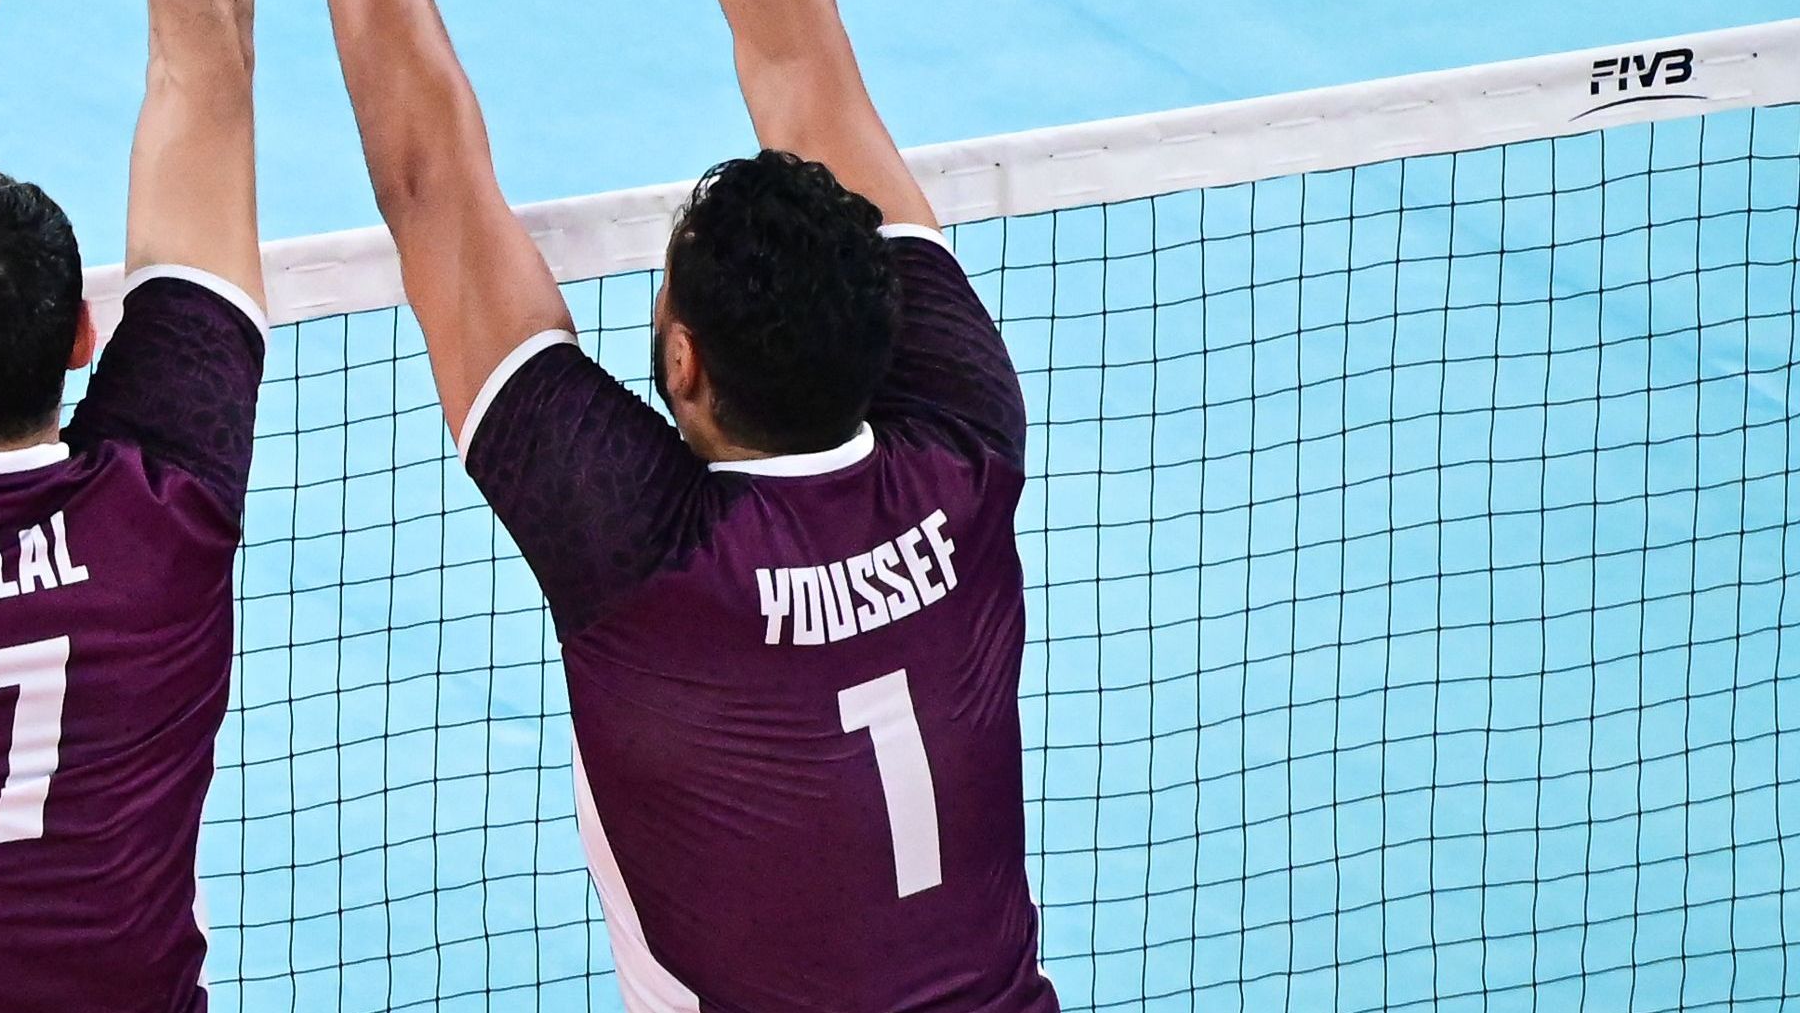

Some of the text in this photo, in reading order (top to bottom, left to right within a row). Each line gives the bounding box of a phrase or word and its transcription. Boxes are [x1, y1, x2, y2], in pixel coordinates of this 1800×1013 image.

[1590, 48, 1694, 96] FIVB
[754, 508, 959, 646] YOUSSEF
[837, 667, 943, 899] 1
